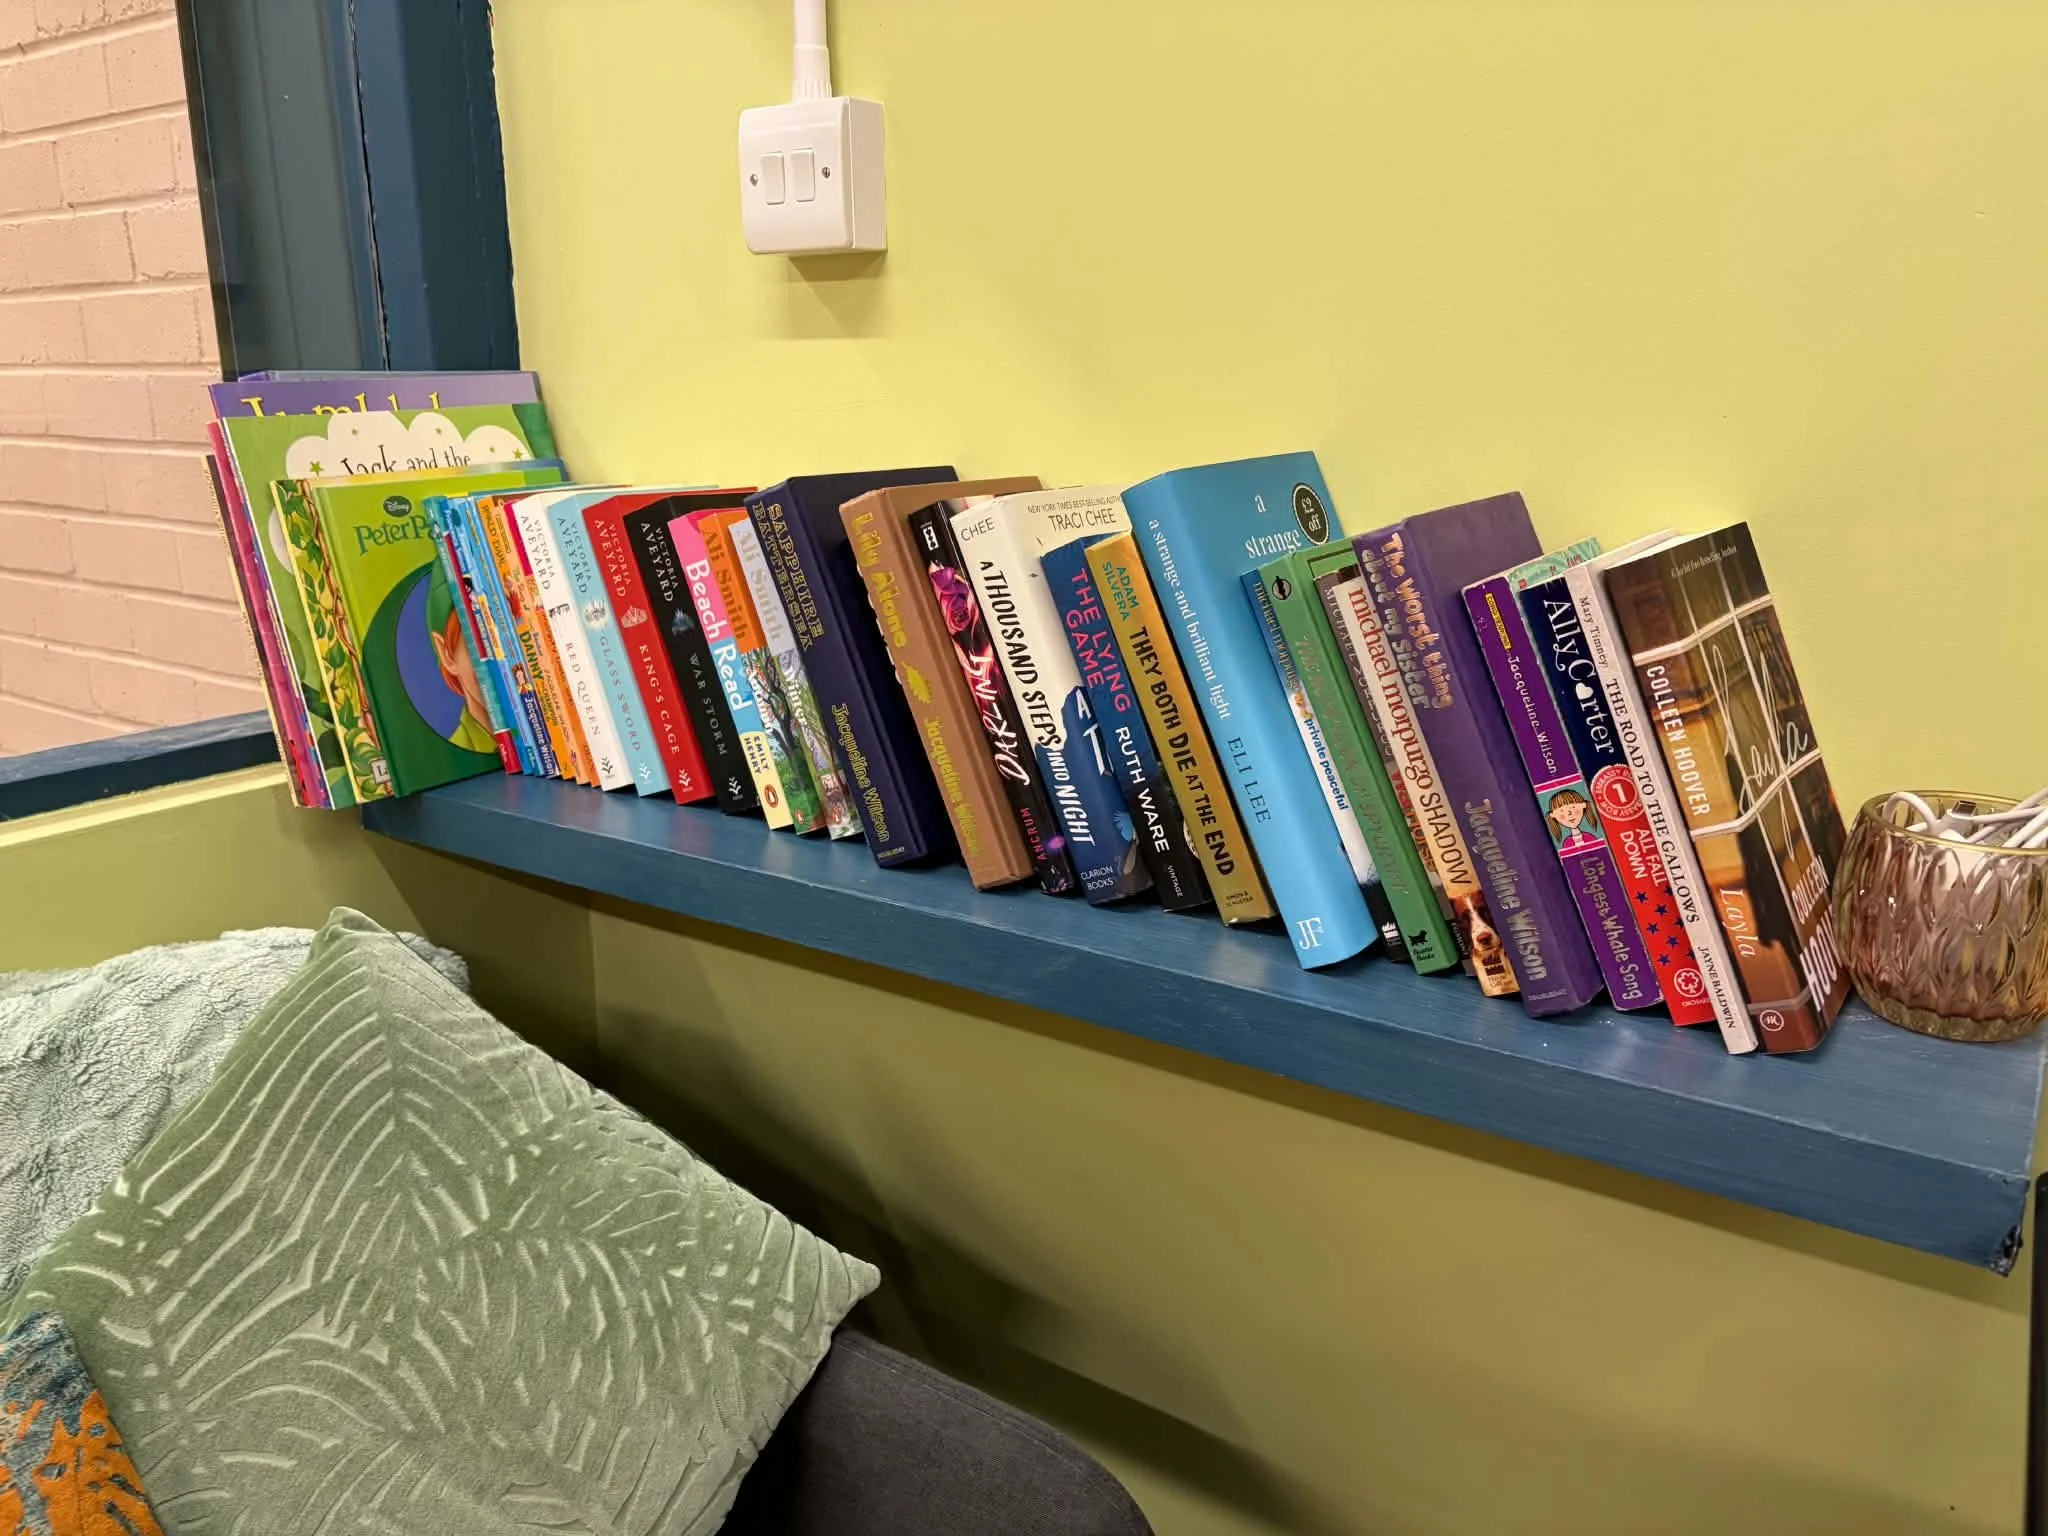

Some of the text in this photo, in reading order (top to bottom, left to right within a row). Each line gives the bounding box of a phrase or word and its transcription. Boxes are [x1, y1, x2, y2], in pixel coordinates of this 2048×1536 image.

[406, 448, 437, 471] and
[444, 446, 470, 468] the
[352, 521, 410, 556] Peter
[960, 517, 995, 541] CHEE
[1027, 505, 1041, 513] NEW
[1041, 503, 1056, 512] YORK
[1057, 501, 1072, 510] TIMES
[1048, 508, 1117, 532] TRACI CHEE
[1254, 494, 1266, 513] a
[1301, 497, 1314, 513] £2
[1308, 514, 1322, 532] off
[520, 515, 551, 590] AVEYARD
[534, 519, 556, 578] VICTORIA
[557, 517, 588, 594] AVEYARD
[571, 522, 592, 581] VICTORIA
[594, 519, 626, 597] AVEYARD
[609, 524, 631, 586] VICTORIA
[640, 522, 673, 602] AVEYARD
[655, 527, 679, 589] VICTORIA
[752, 502, 814, 652] BATTERSEA
[767, 503, 825, 638] SAPPHIRE
[853, 512, 908, 647] Lily Alone
[979, 560, 994, 571] A
[1245, 529, 1302, 559] strange
[1381, 533, 1405, 577] The
[686, 560, 728, 640] Beach
[702, 528, 750, 641] Ali Smith
[735, 528, 785, 642] Ali Smith
[1102, 561, 1130, 622] SILVERA
[1116, 567, 1140, 608] ADAM
[1149, 519, 1233, 720] a strange and brilliant light
[1253, 583, 1281, 631] michael
[1361, 550, 1396, 603] about
[1383, 607, 1404, 635] my
[519, 630, 545, 680] DANNY
[983, 570, 1039, 684] THOUSAND
[1066, 609, 1104, 689] GAME
[1071, 568, 1101, 624] THE
[1091, 631, 1132, 712] LYING
[1544, 599, 1581, 672] Ally
[565, 642, 580, 673] RED
[577, 680, 600, 736] QUEEN
[599, 635, 642, 752] GLASS SWORD
[639, 644, 681, 754] KING'S CAGE
[689, 653, 728, 755] WAR STORM
[713, 643, 753, 711] Read
[782, 666, 808, 726] Winter
[525, 697, 556, 778] Jacqueline Wilson
[962, 650, 1031, 786] DARLING
[1022, 690, 1062, 750] STEPS
[1130, 626, 1235, 876] THEY BOTH DIE AT THE END
[1348, 588, 1399, 678] michael
[1380, 681, 1434, 790] morpurgo
[1419, 792, 1473, 885] SHADOW
[1508, 655, 1557, 775] Jacqueline Wilson
[1646, 665, 1711, 817] COLLEEN HOOVER
[743, 736, 762, 774] HENRY
[753, 735, 769, 772] EMILY
[832, 703, 890, 843] Jacqueline Wilson
[925, 716, 965, 805] Jacqueline
[1047, 750, 1070, 781] INTO
[1115, 727, 1170, 853] RUTH WARE
[1228, 737, 1272, 824] ELI LEE
[1304, 718, 1327, 760] private
[1320, 757, 1349, 811] peaceful
[1579, 596, 1594, 624] Mary
[1605, 678, 1629, 716] THE
[1619, 720, 1645, 768] ROAD
[1638, 771, 1655, 796] TO
[1648, 799, 1670, 837] THE
[1661, 839, 1700, 924] GALLOWS
[1053, 784, 1096, 847] NIGHT
[1612, 783, 1627, 803] 1
[1020, 808, 1047, 861] ANCRUM
[1620, 832, 1648, 879] DOWN
[1636, 828, 1667, 888] ALL FALL
[1080, 866, 1113, 880] CLARION
[1087, 878, 1114, 891] BOOKS
[1168, 865, 1183, 897] VINTAGE
[1465, 798, 1547, 981] Jacqueline Wilson
[1791, 853, 1830, 925] COLLEEN
[1580, 857, 1643, 1001] Longest Whale Song
[1719, 888, 1760, 958] Layla
[1800, 903, 1844, 1013] HOOV
[1698, 946, 1736, 1029] JAYNE BALDWIN
